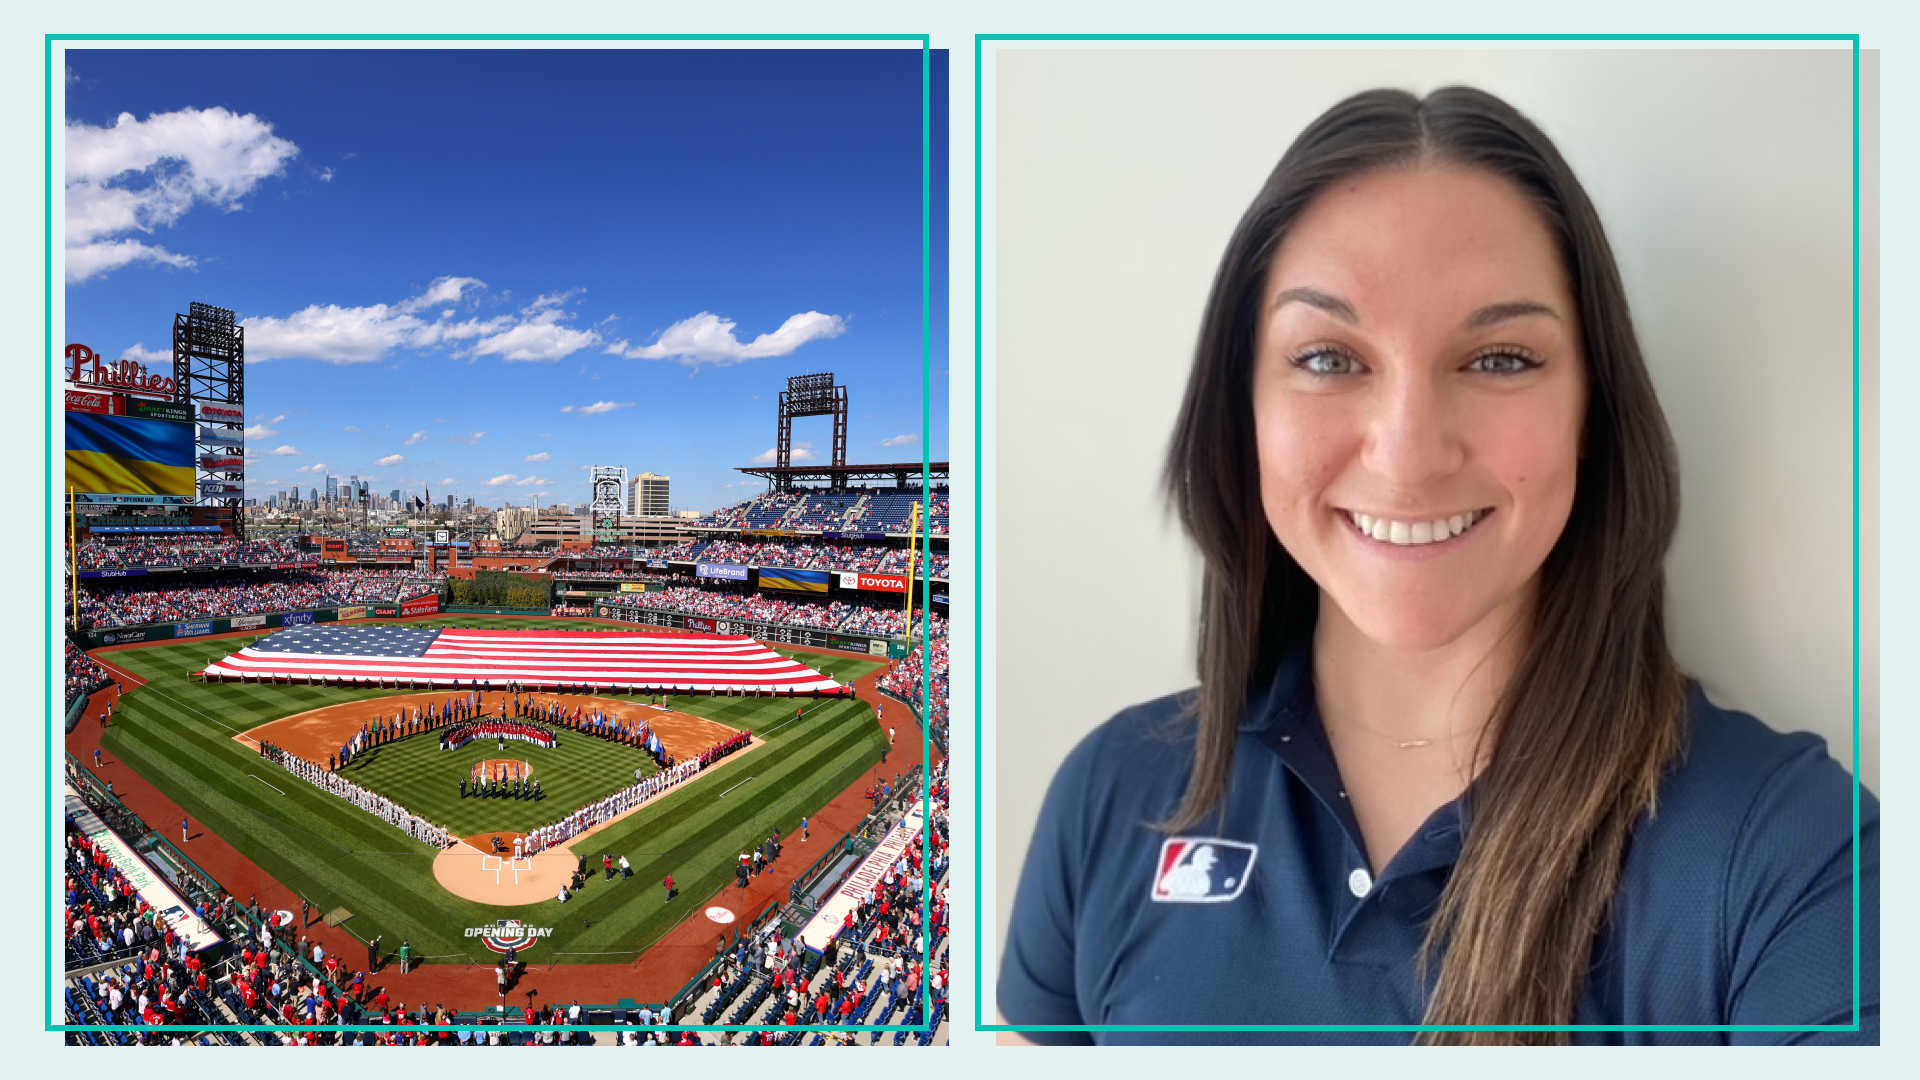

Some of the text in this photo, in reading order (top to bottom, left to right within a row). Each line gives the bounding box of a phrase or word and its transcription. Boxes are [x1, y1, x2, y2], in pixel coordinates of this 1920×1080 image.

[65, 343, 177, 393] Phillies
[139, 405, 187, 415] DRAFTKINGS
[212, 407, 243, 417] TOYOTA
[150, 412, 187, 420] SPORTSBOOK
[89, 516, 189, 525] Citizens Bank Park
[710, 567, 745, 577] LifeBrand
[860, 578, 904, 589] TOYOTA
[284, 613, 312, 627] xfinity
[687, 618, 712, 631] Phillies
[184, 622, 210, 630] SHERWIN
[116, 631, 146, 640] NovaCare
[830, 639, 867, 648] DRAFTKINGS
[100, 838, 154, 888] Citizens Bank Park
[840, 850, 896, 900] PHILADELPHIA
[464, 928, 554, 937] OPENING DAY
